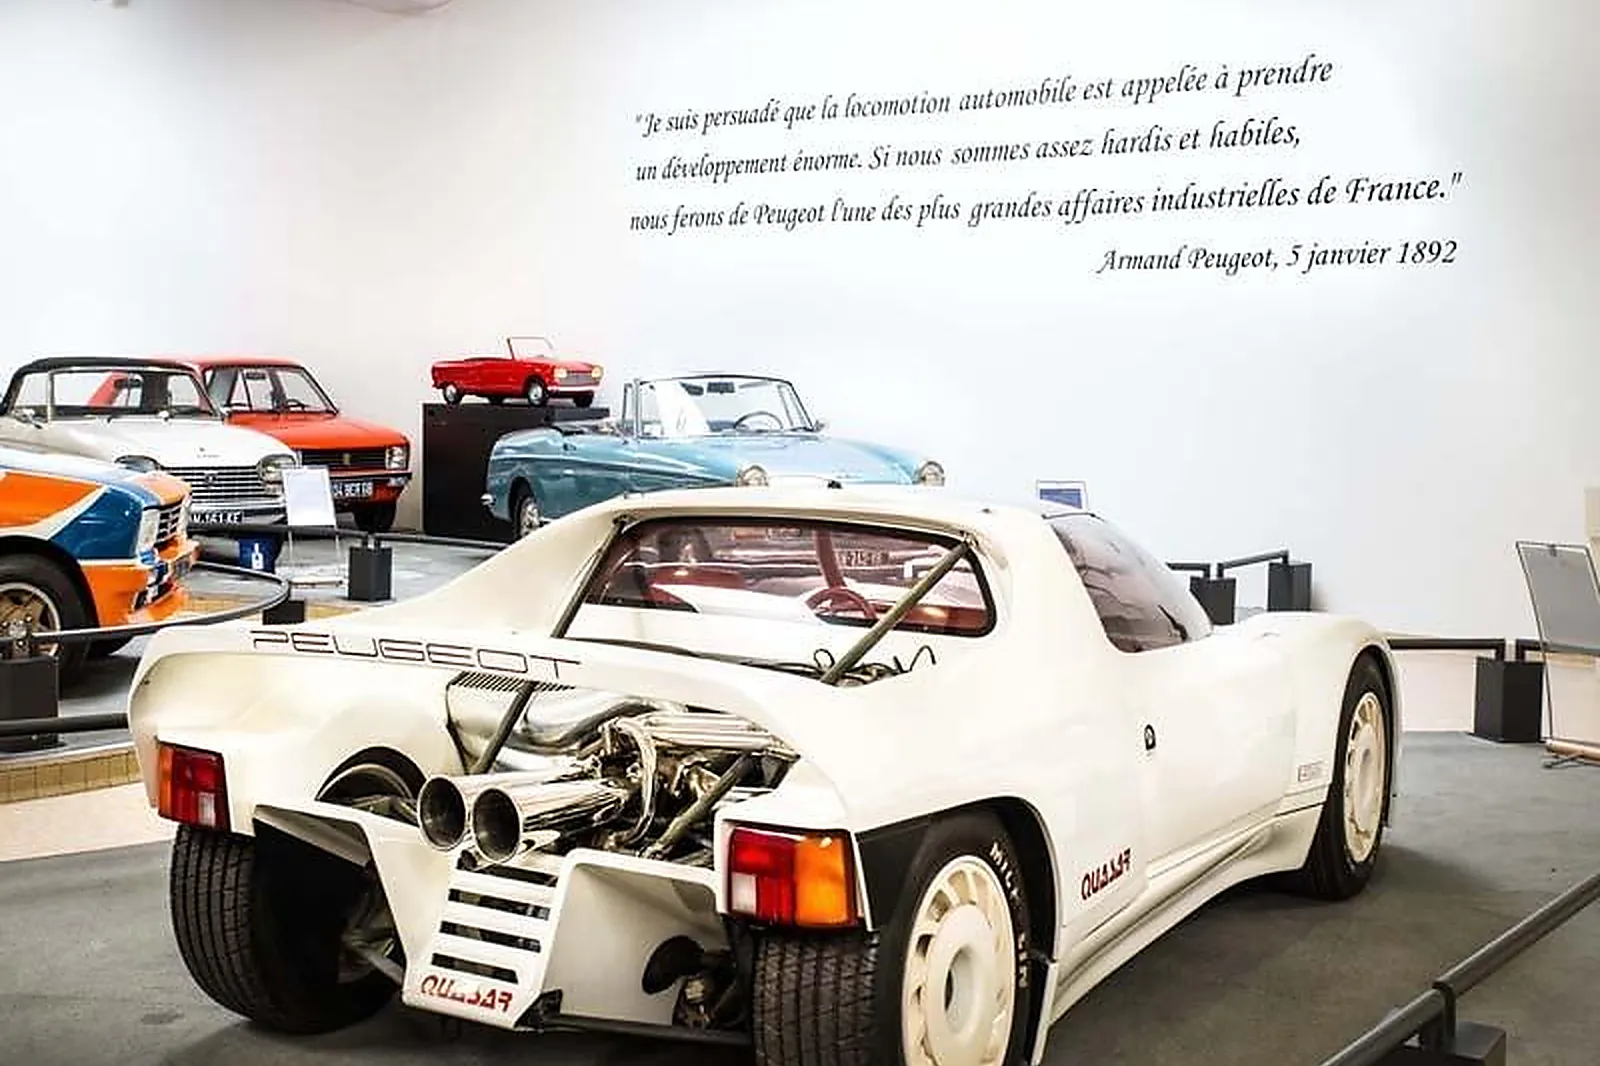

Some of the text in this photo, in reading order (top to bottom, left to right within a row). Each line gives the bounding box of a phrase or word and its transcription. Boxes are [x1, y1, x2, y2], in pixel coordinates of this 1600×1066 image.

[665, 108, 699, 132] suis
[701, 98, 781, 136] persuadé
[783, 104, 816, 130] que
[821, 94, 839, 120] la
[844, 91, 951, 118] locomotion
[959, 75, 1077, 111] automobile
[1083, 78, 1113, 101] est
[1121, 64, 1208, 103] appelée
[1214, 64, 1229, 90] à
[1236, 53, 1333, 94] prendre
[636, 116, 1300, 184] un développement énorme. Si nous sommes assez hardis et habiles,
[630, 171, 1463, 236] nous ferons de Peugeot l'une des plus grandes affaires industrielles de France."
[1097, 240, 1458, 276] Armand Peugeot, 5 janvier 1892
[249, 629, 582, 679] PEUGEOT
[1081, 847, 1131, 901] QUASAR
[421, 974, 514, 1012] QUASAR
